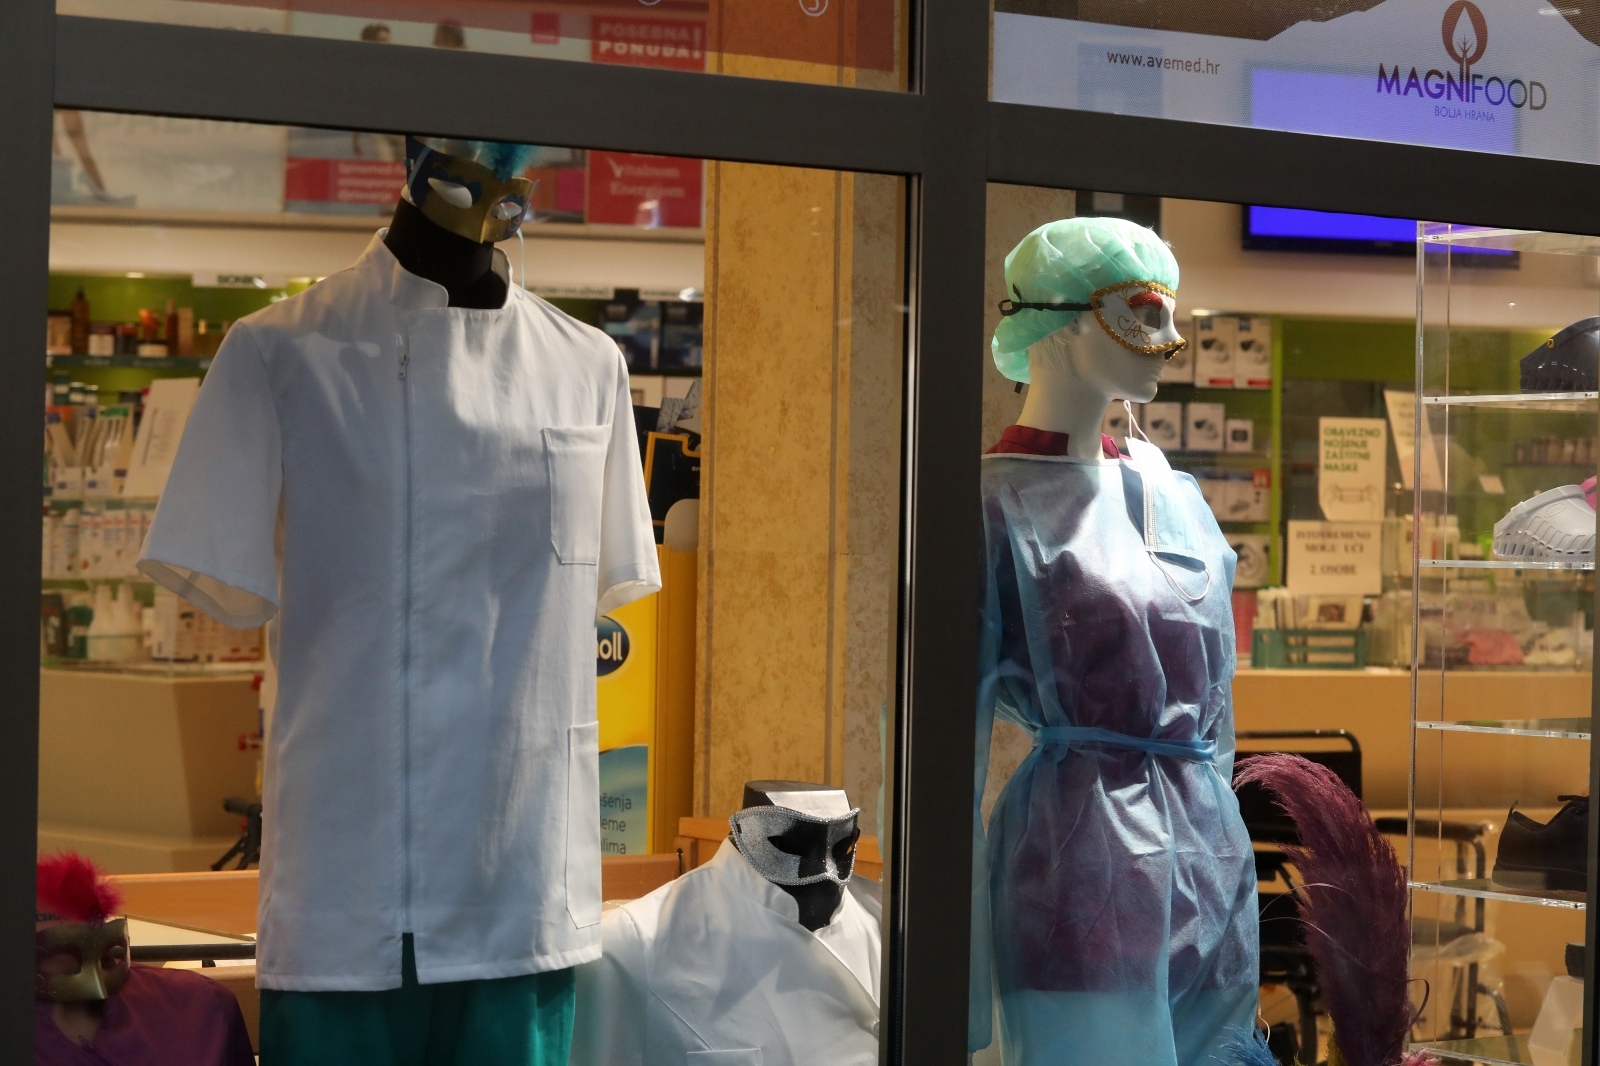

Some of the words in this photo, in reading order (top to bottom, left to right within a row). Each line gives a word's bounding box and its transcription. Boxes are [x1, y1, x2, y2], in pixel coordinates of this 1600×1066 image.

[1106, 52, 1220, 75] www.avemed.hr
[1377, 62, 1547, 111] MAGNIFOOD
[1434, 105, 1462, 119] BOLJA
[1464, 108, 1495, 122] HRANA
[1323, 427, 1381, 438] OBAVEZNO
[1323, 462, 1359, 473] MASKE
[600, 792, 632, 812] šenja
[600, 817, 626, 832] eme
[601, 837, 627, 855] lima
